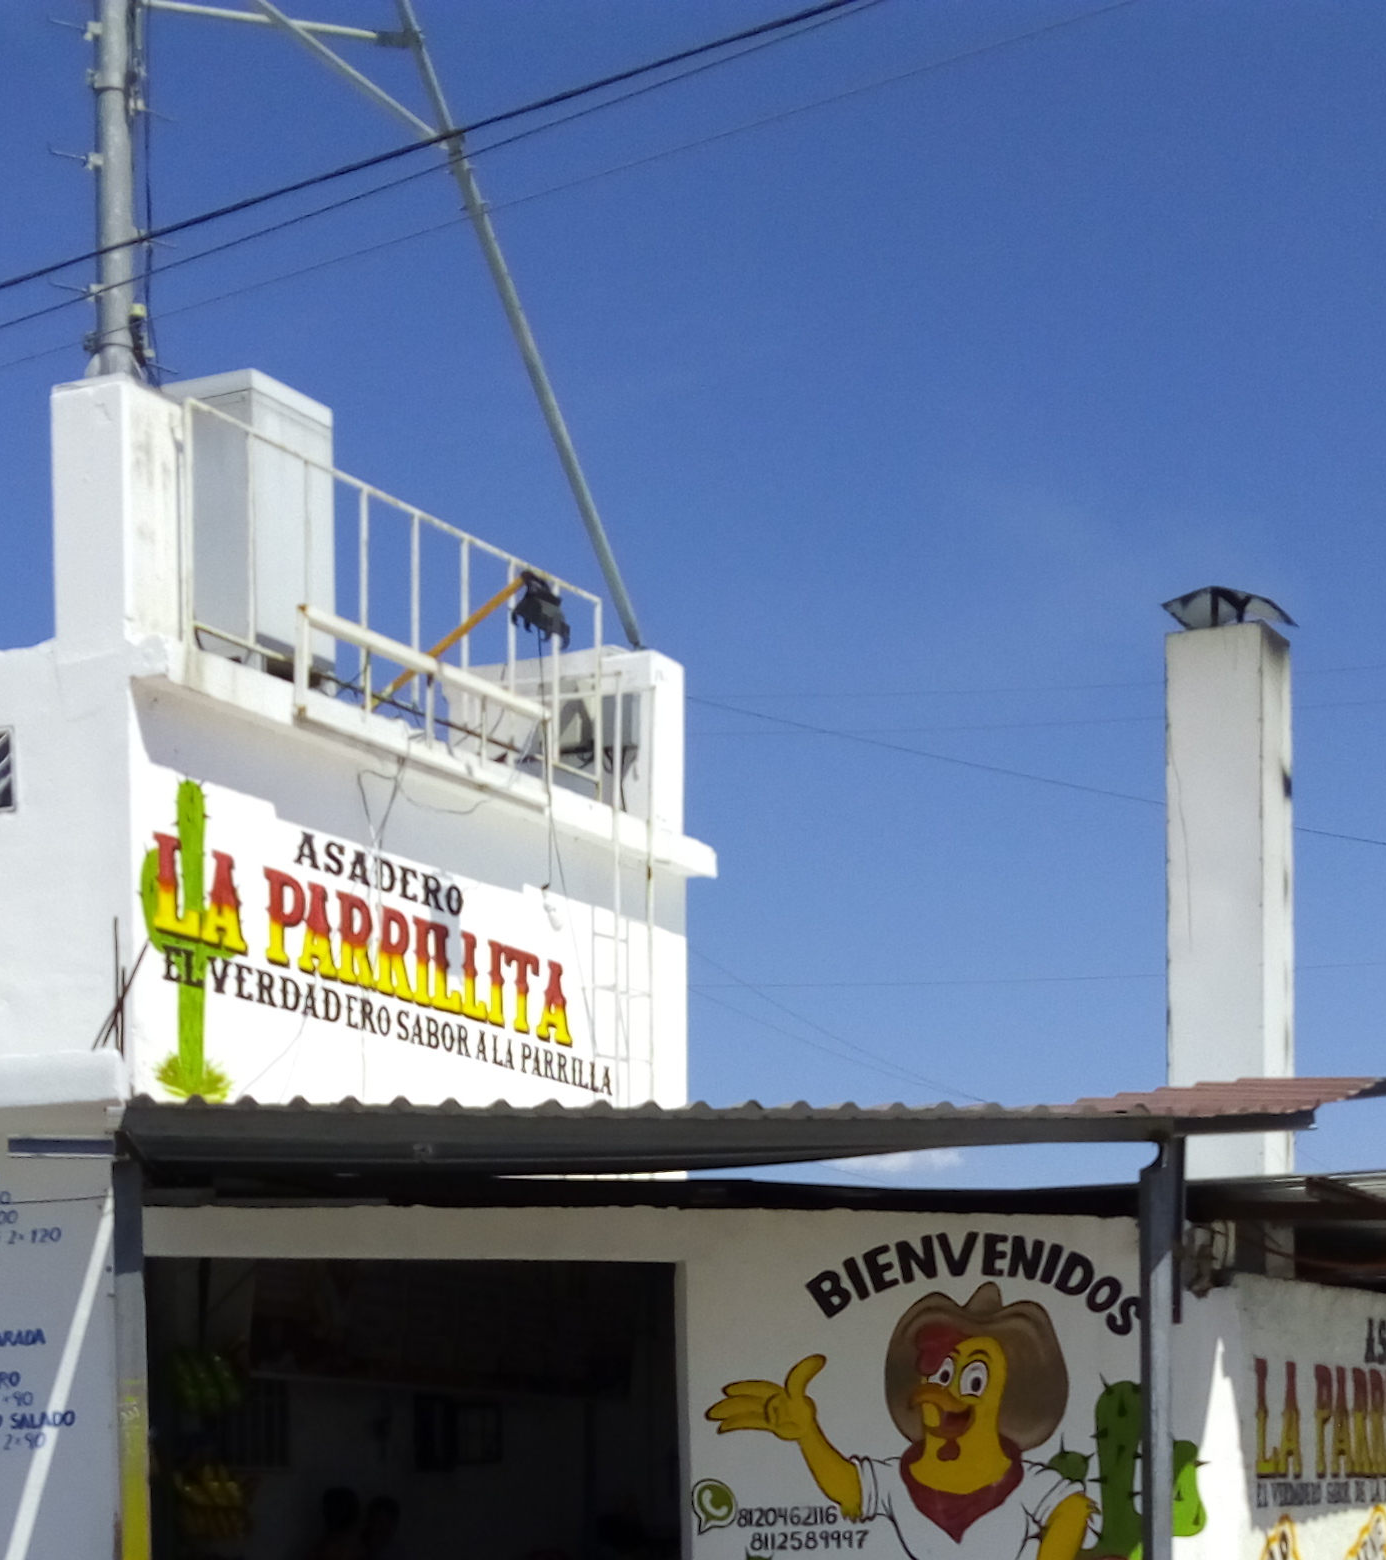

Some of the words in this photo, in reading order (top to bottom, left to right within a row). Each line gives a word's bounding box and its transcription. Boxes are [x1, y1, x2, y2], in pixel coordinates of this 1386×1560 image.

[294, 831, 465, 918] ASADERO
[152, 830, 248, 957] LA
[263, 866, 574, 1049] PARRILLITA
[163, 944, 201, 992] EL
[205, 956, 392, 1038] VERDADERO
[396, 1011, 471, 1060] SABOR
[520, 1046, 614, 1098] PARRILLA
[806, 1231, 1142, 1336] BIENVENIDOS
[10, 1410, 76, 1429] SALADO
[1254, 1356, 1302, 1479] LA
[737, 1505, 838, 1528] 8120462116
[750, 1529, 869, 1551] 8112589997
